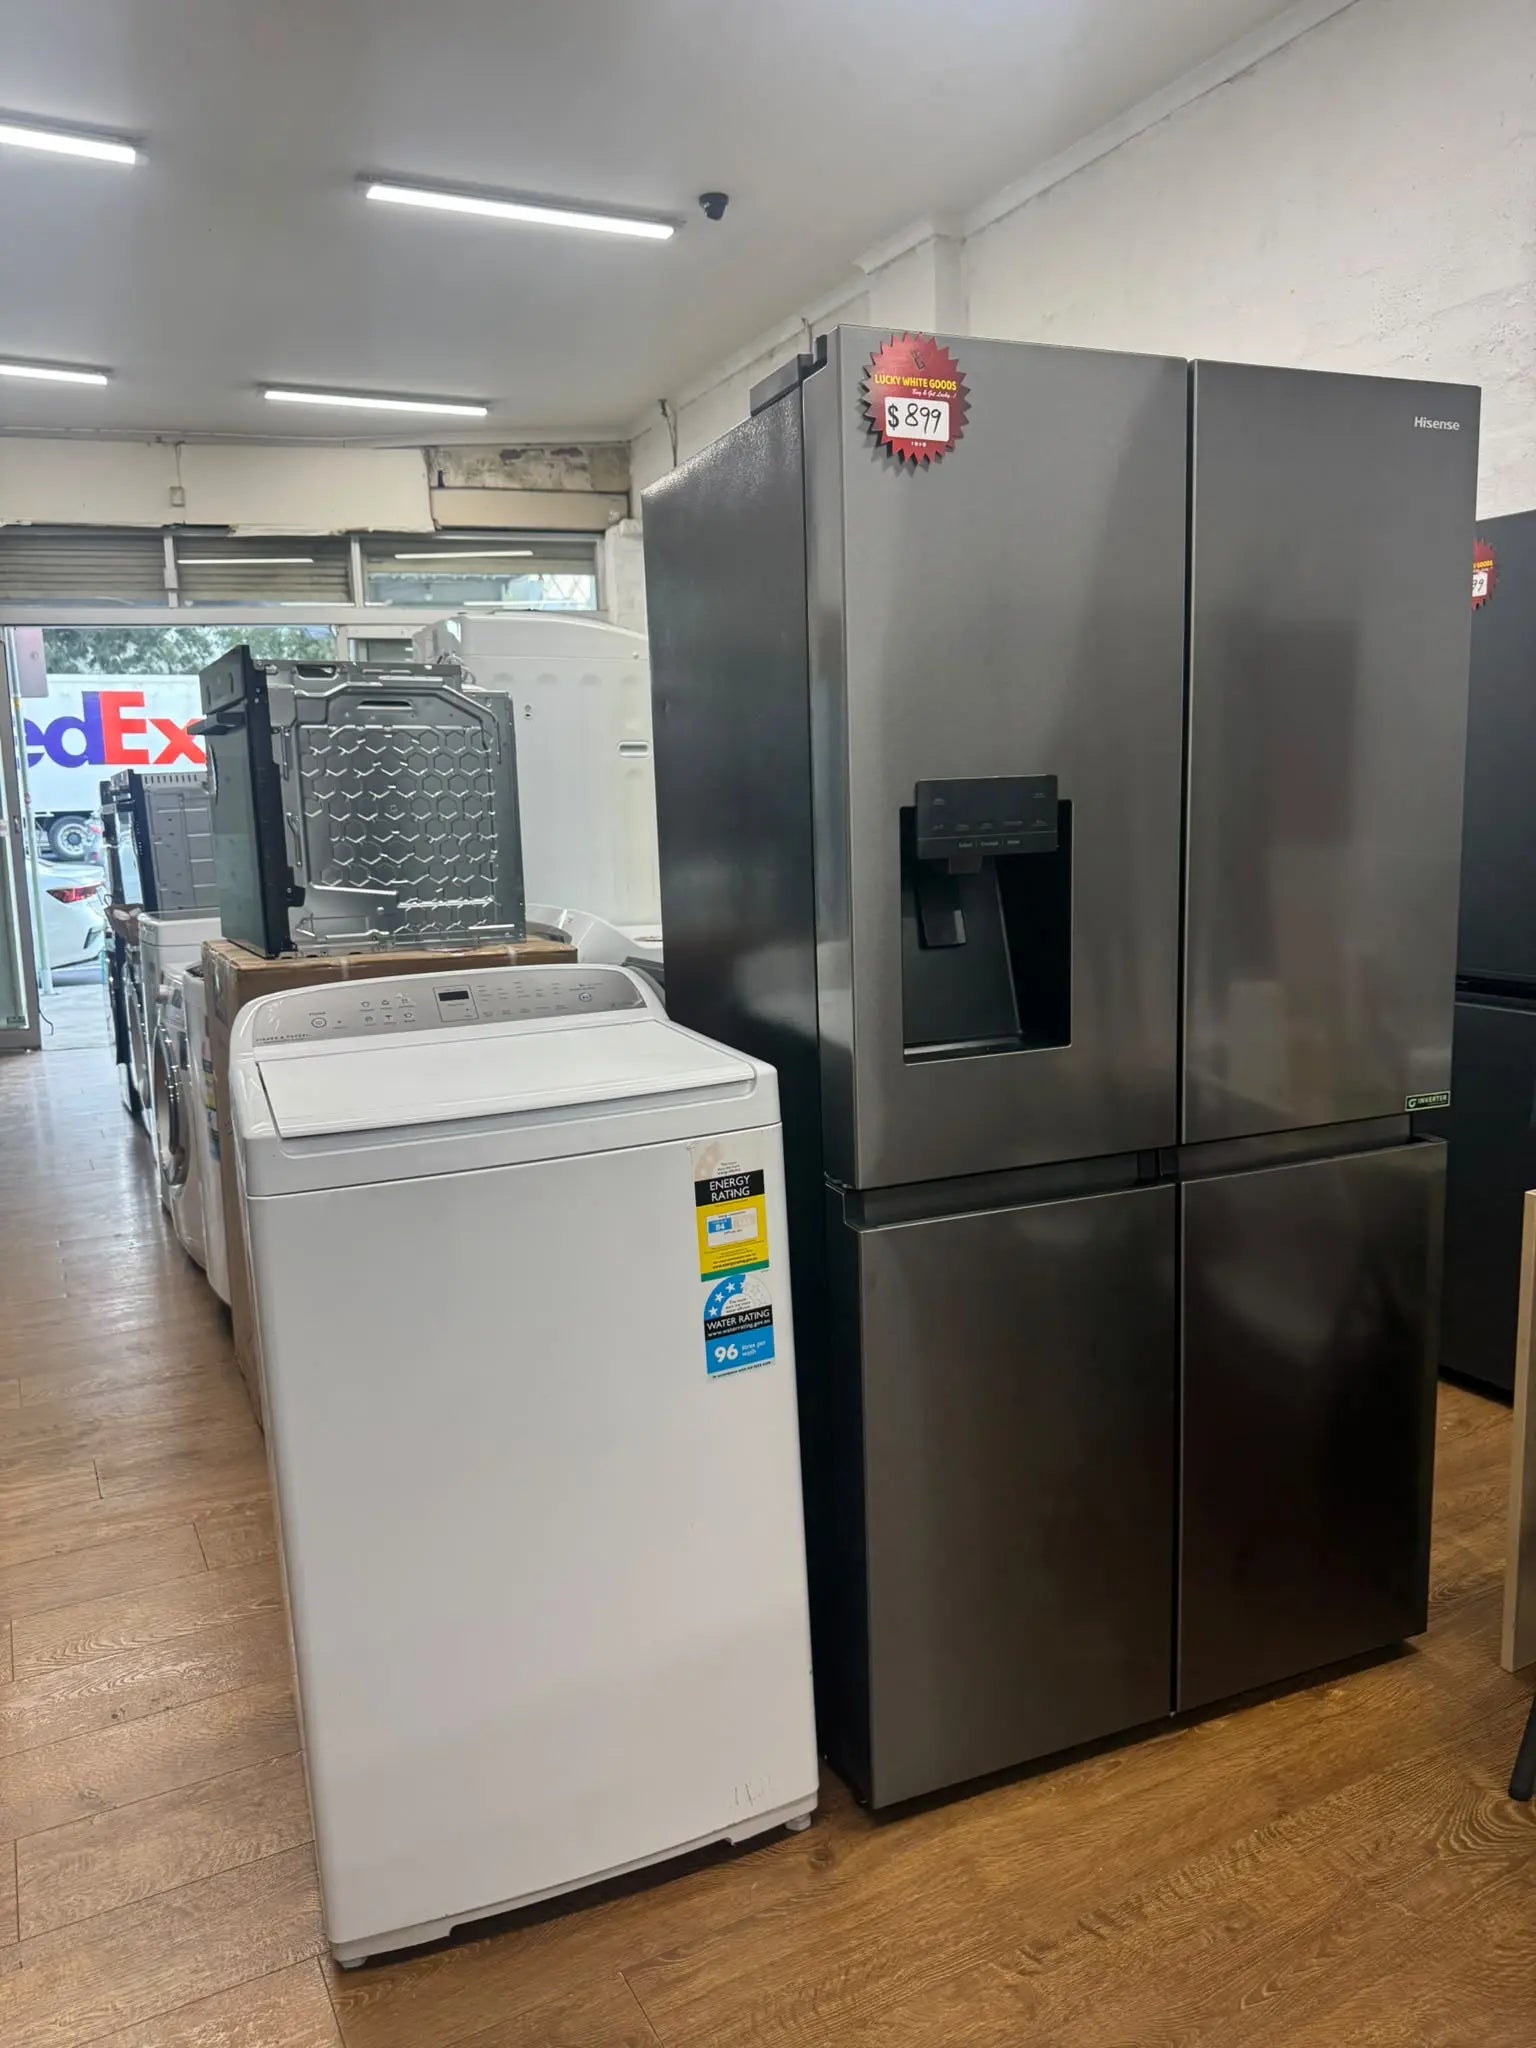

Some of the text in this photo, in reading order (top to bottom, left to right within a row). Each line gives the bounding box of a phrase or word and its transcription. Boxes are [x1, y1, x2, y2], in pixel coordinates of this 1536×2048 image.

[874, 374, 957, 391] LUCKY WHITE GOODS
[1414, 416, 1460, 431] Hisense
[22, 691, 207, 769] edEx
[709, 1175, 750, 1191] ENERGY
[711, 1186, 750, 1202] RATING
[707, 1309, 770, 1330] WATER RATING
[714, 1343, 739, 1363] 96
